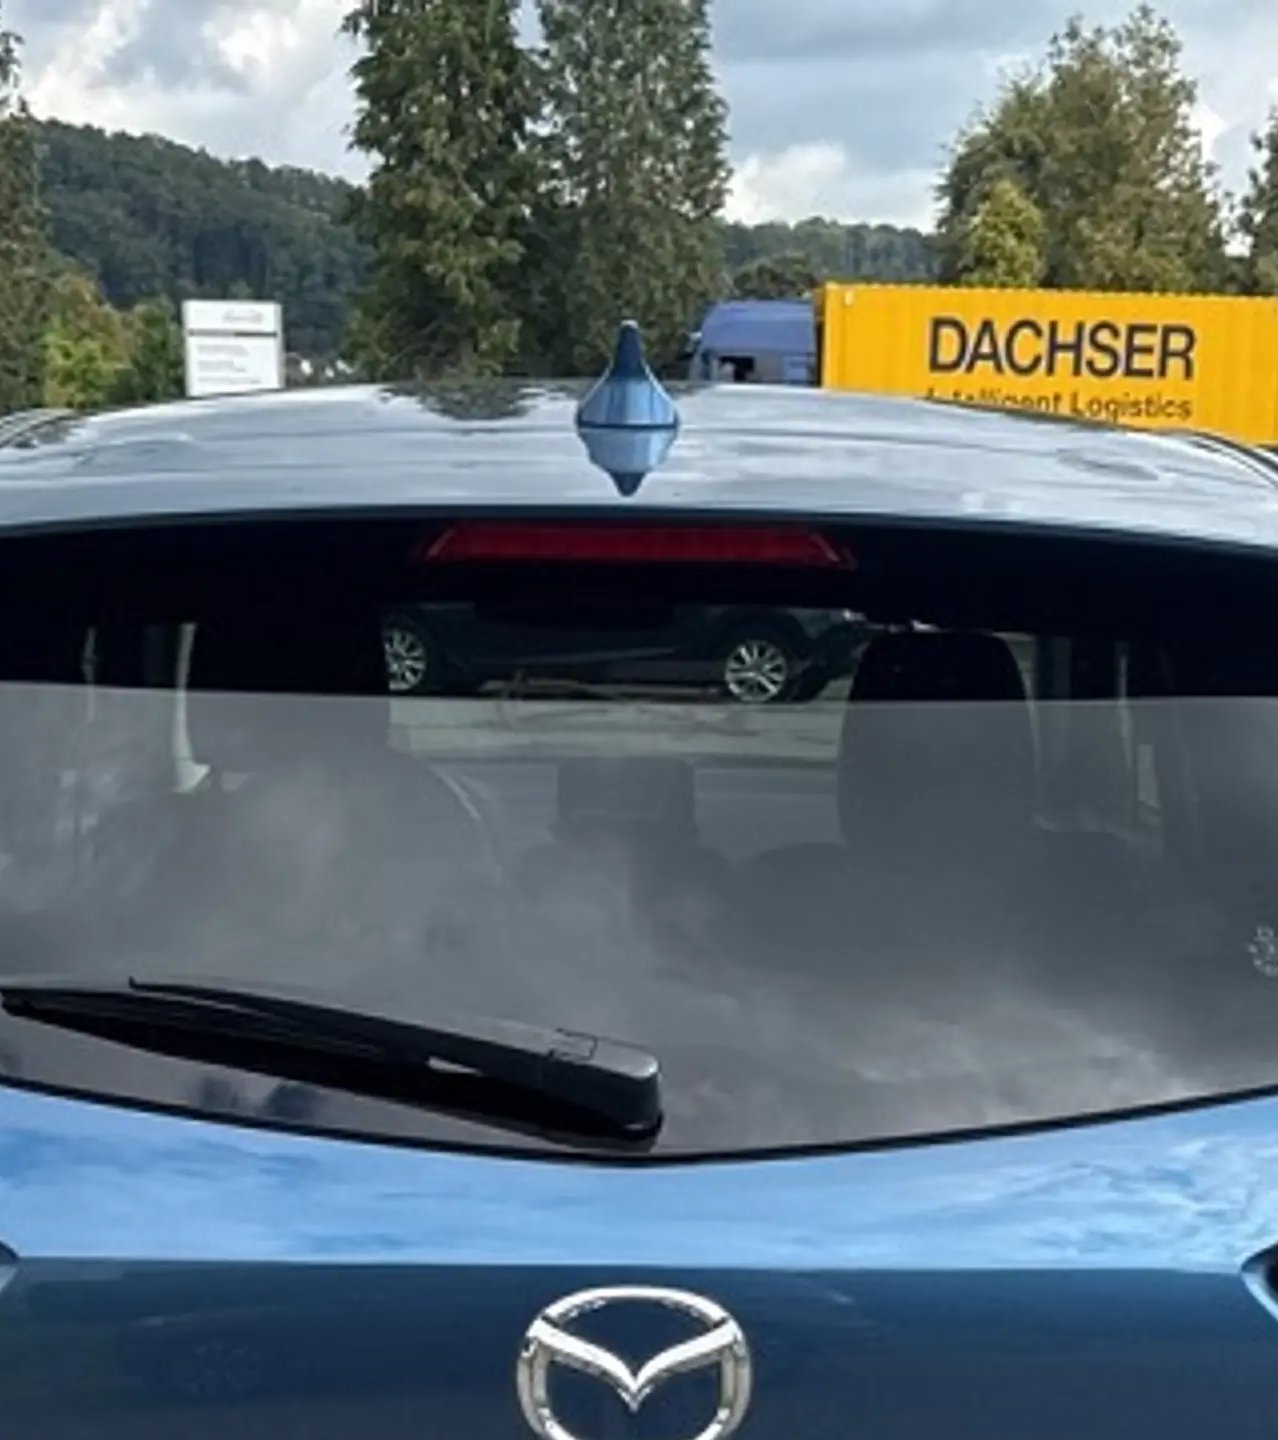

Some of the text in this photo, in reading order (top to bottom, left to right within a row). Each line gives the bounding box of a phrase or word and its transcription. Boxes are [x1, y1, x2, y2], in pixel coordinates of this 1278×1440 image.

[928, 316, 1195, 380] DACHSER
[925, 386, 1194, 421] Itelligent Logistics
